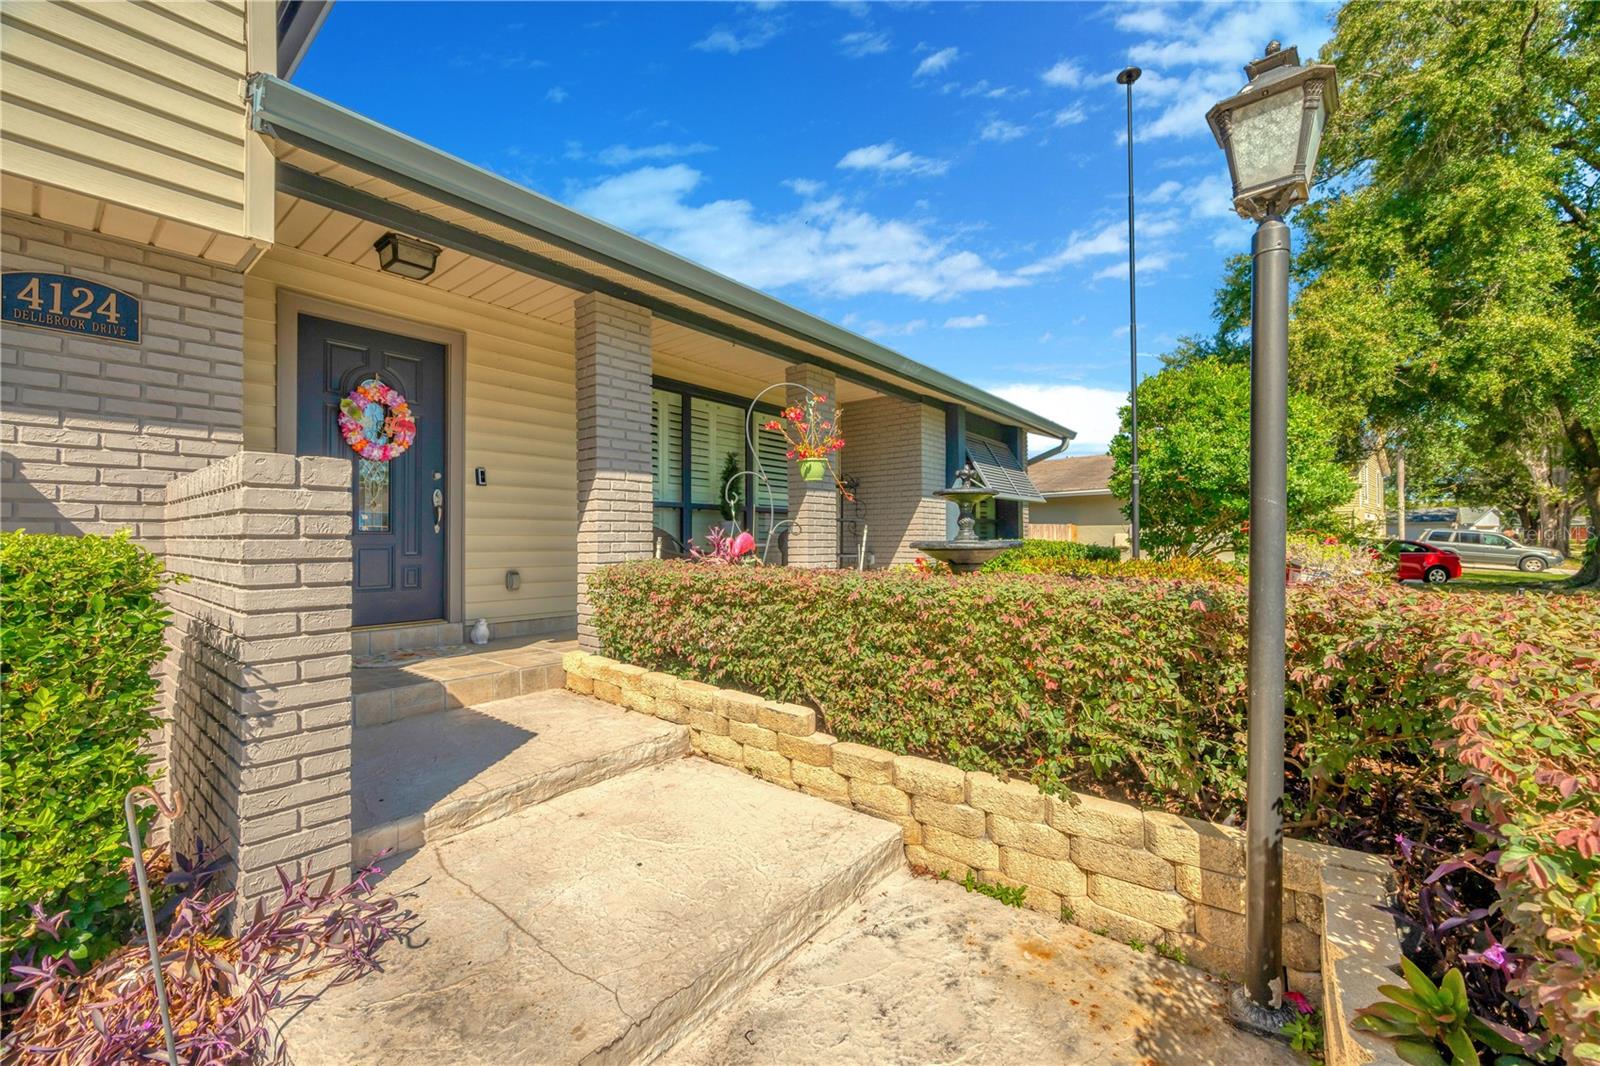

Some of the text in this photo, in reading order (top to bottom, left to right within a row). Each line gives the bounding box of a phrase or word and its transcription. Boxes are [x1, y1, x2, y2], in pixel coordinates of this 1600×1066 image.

[16, 277, 121, 324] 4124
[13, 308, 127, 337] DELLBROOK DRIVE
